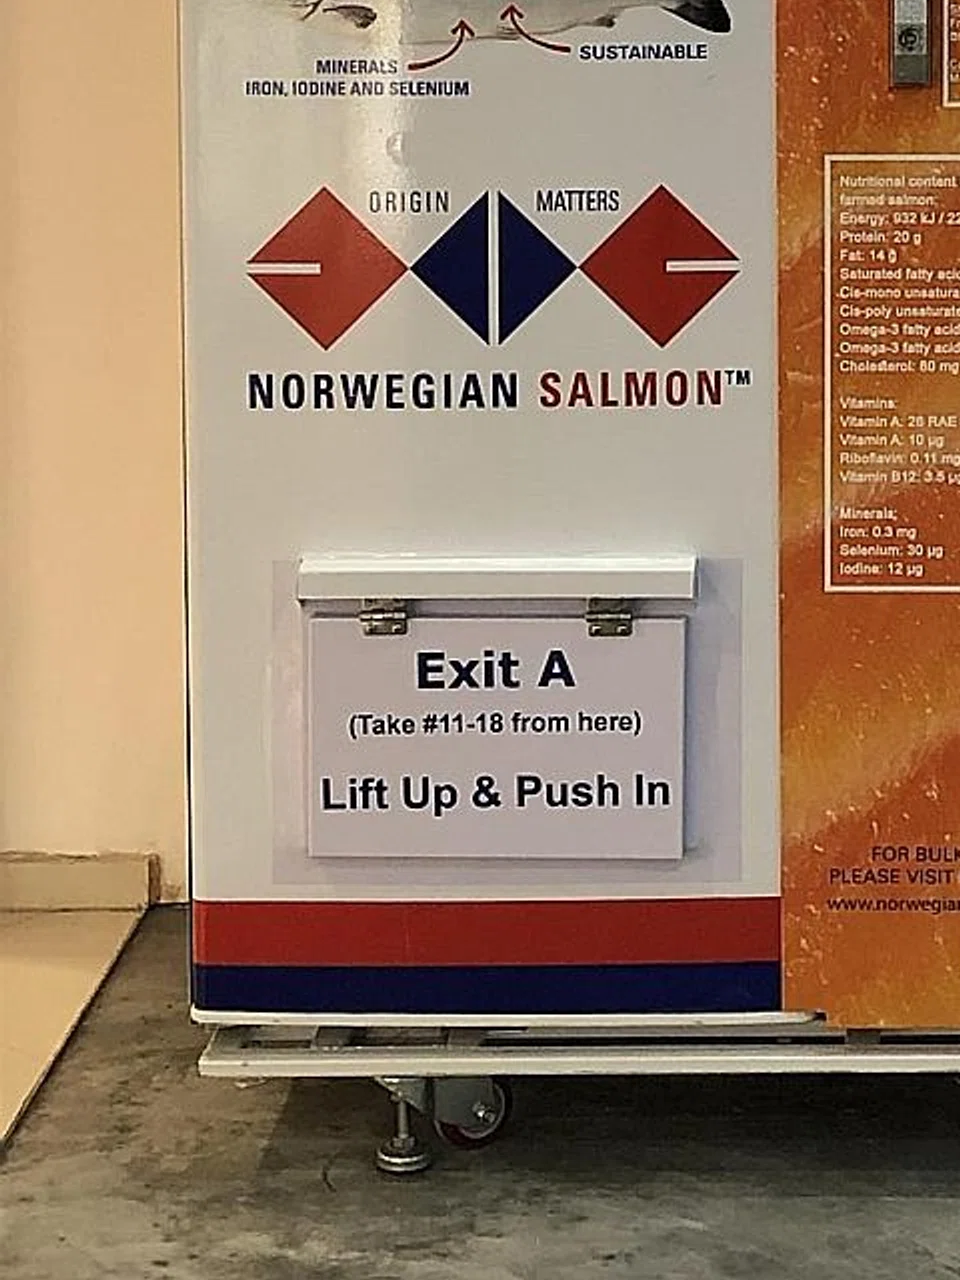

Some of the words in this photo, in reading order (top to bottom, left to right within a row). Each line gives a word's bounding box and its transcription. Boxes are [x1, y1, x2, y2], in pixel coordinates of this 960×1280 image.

[579, 45, 707, 60] SUSTAINABLE
[316, 59, 397, 75] MINERALS
[246, 81, 288, 97] IRON,
[292, 81, 345, 96] IODINE
[350, 81, 384, 96] AND
[390, 81, 469, 96] SELENIUM
[840, 176, 905, 187] Nutritional
[908, 177, 957, 187] content
[370, 191, 449, 212] ORIGIN
[536, 190, 620, 212] MATTERS
[248, 372, 518, 408] NORWEGIAN
[907, 545, 923, 556] 30
[840, 563, 882, 574] Iodine:
[887, 563, 902, 574] 12
[417, 650, 520, 689] Exit
[538, 650, 576, 688] A
[349, 713, 415, 738] (Take
[422, 713, 503, 734] #11-18
[512, 712, 569, 732] from
[578, 710, 641, 736] here)
[322, 777, 388, 810] Lift
[402, 776, 457, 817] Up
[472, 775, 501, 809] &
[516, 774, 619, 808] Push
[636, 774, 670, 806] In
[872, 847, 909, 861] FOR
[830, 870, 899, 884] PLEASE
[908, 871, 954, 884] VISIT
